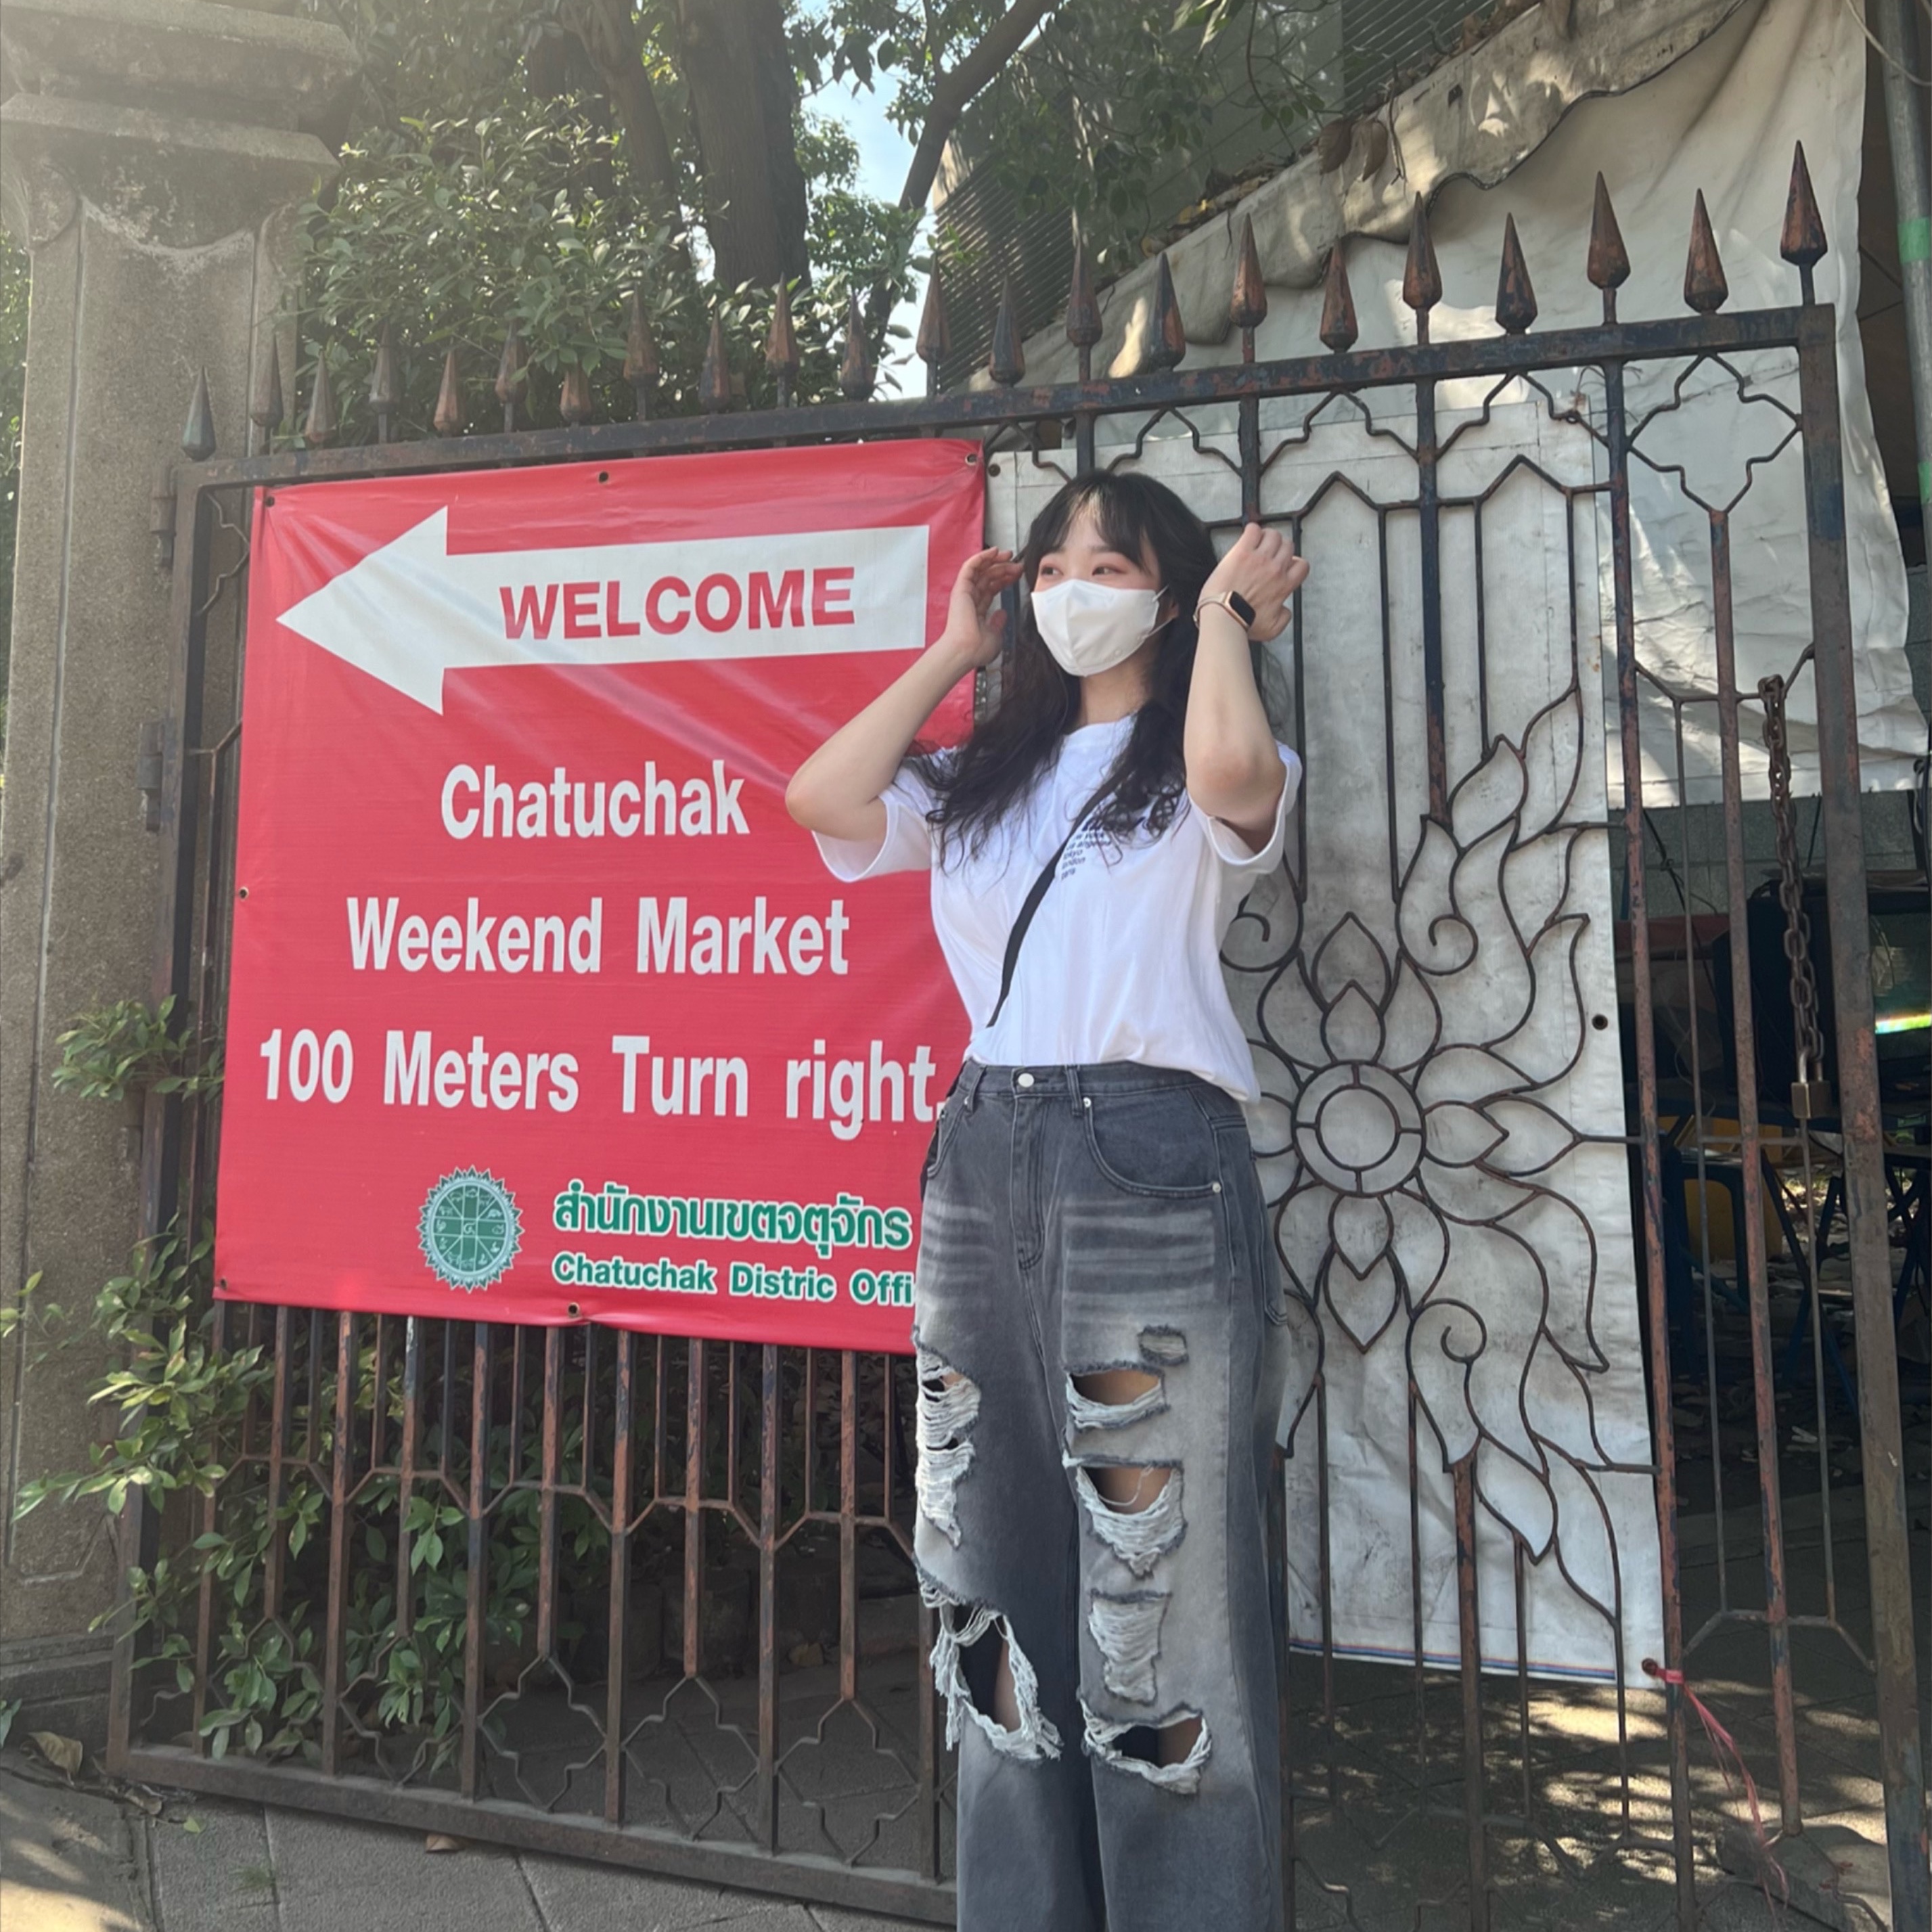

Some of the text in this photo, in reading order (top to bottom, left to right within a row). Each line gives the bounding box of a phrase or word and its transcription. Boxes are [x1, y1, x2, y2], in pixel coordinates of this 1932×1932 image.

[501, 568, 854, 639] WELCOME
[441, 759, 750, 839] Chatuchak
[346, 897, 849, 975] Weekend Market
[261, 1029, 353, 1103] 100
[384, 1030, 579, 1112] Meters
[612, 1035, 748, 1117] Turn
[552, 1179, 912, 1259] สำนักงานเขตจตุจักร
[552, 1252, 914, 1307] Chatuchak Distric Offi
